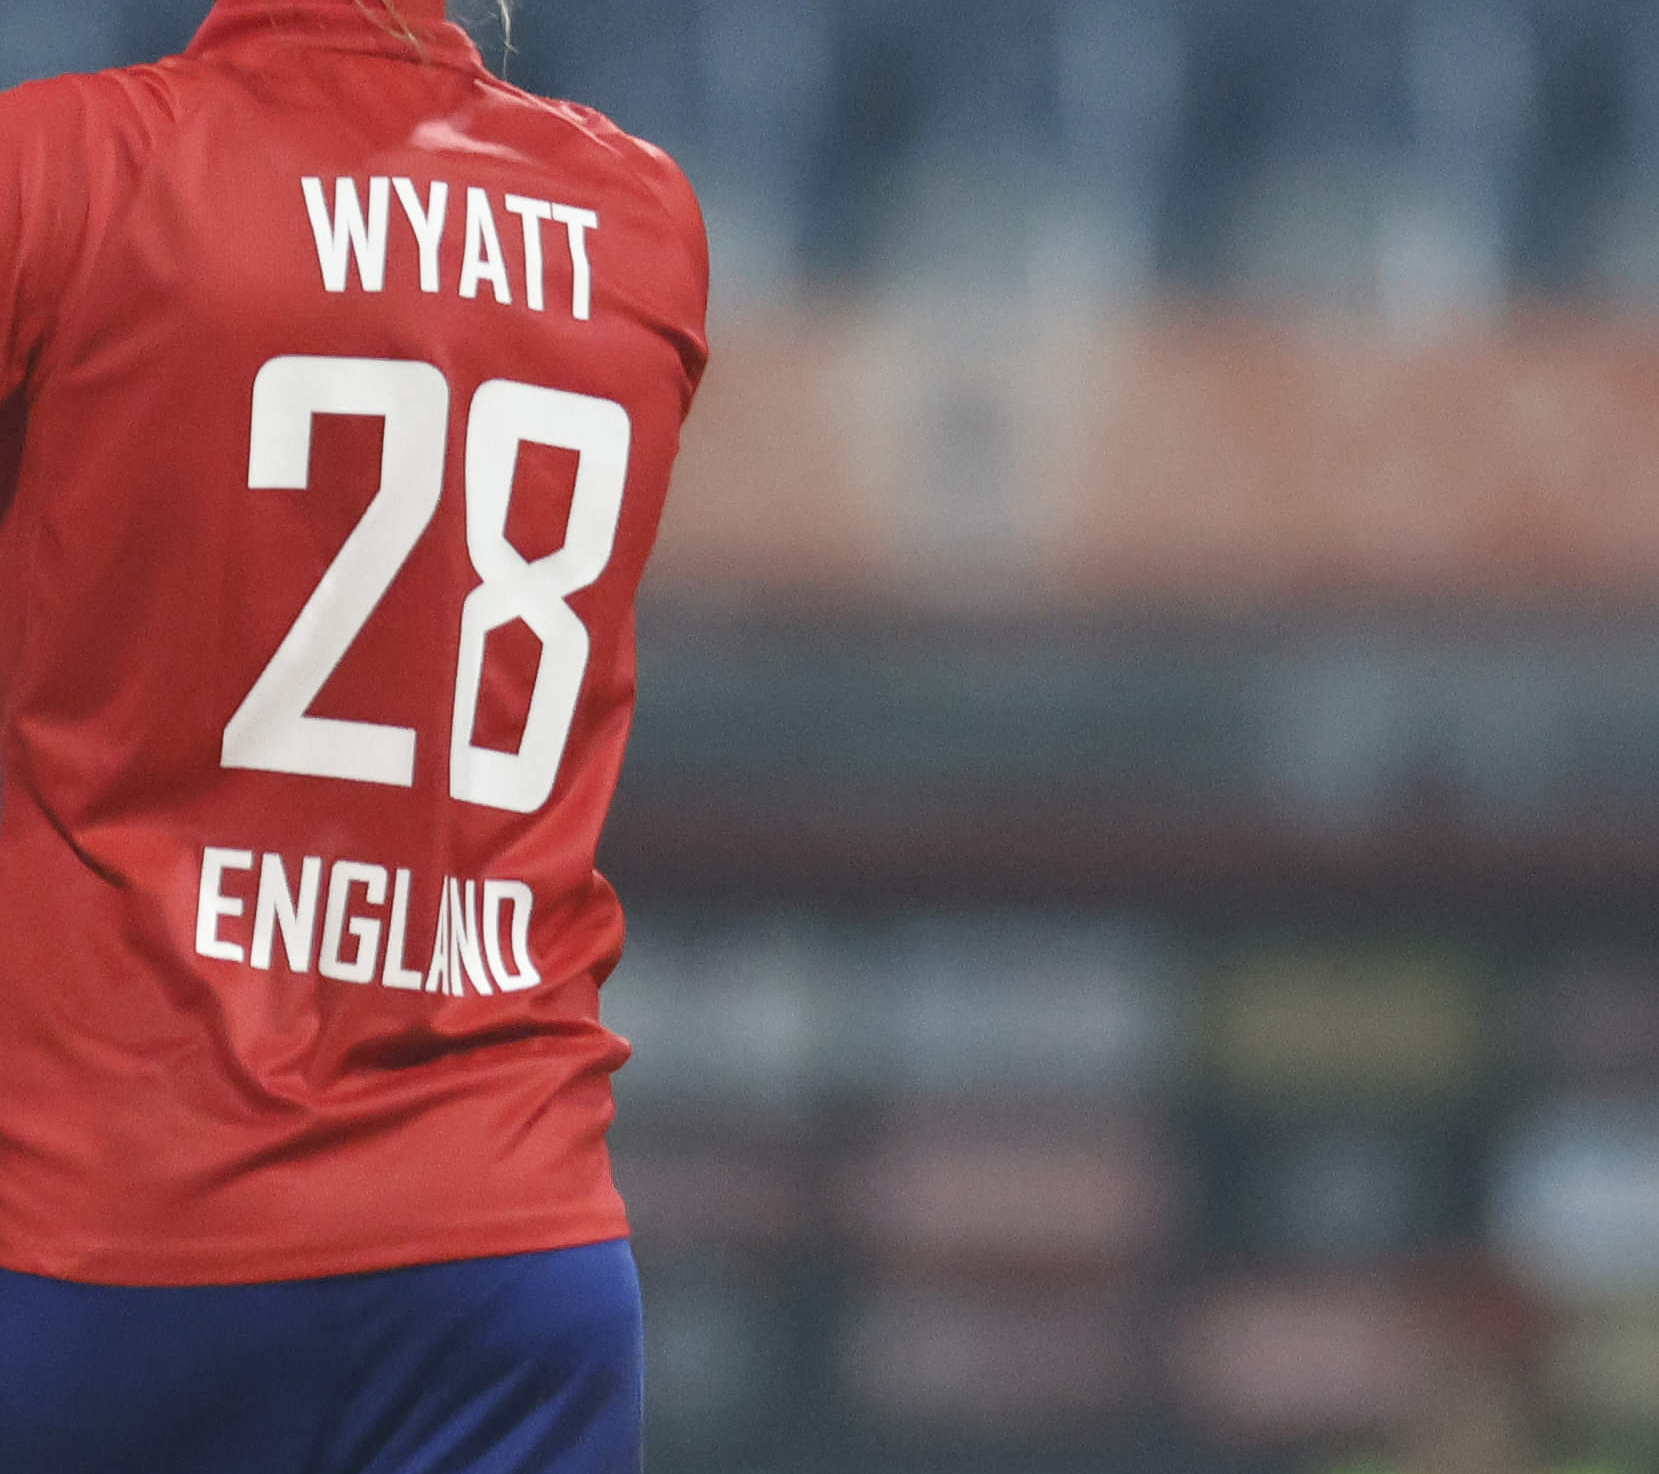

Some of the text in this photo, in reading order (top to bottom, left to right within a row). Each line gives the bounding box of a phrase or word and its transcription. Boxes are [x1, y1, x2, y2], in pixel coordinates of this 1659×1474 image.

[300, 176, 598, 320] WYATT
[219, 353, 631, 814] 28
[195, 846, 540, 997] ENGLAND
